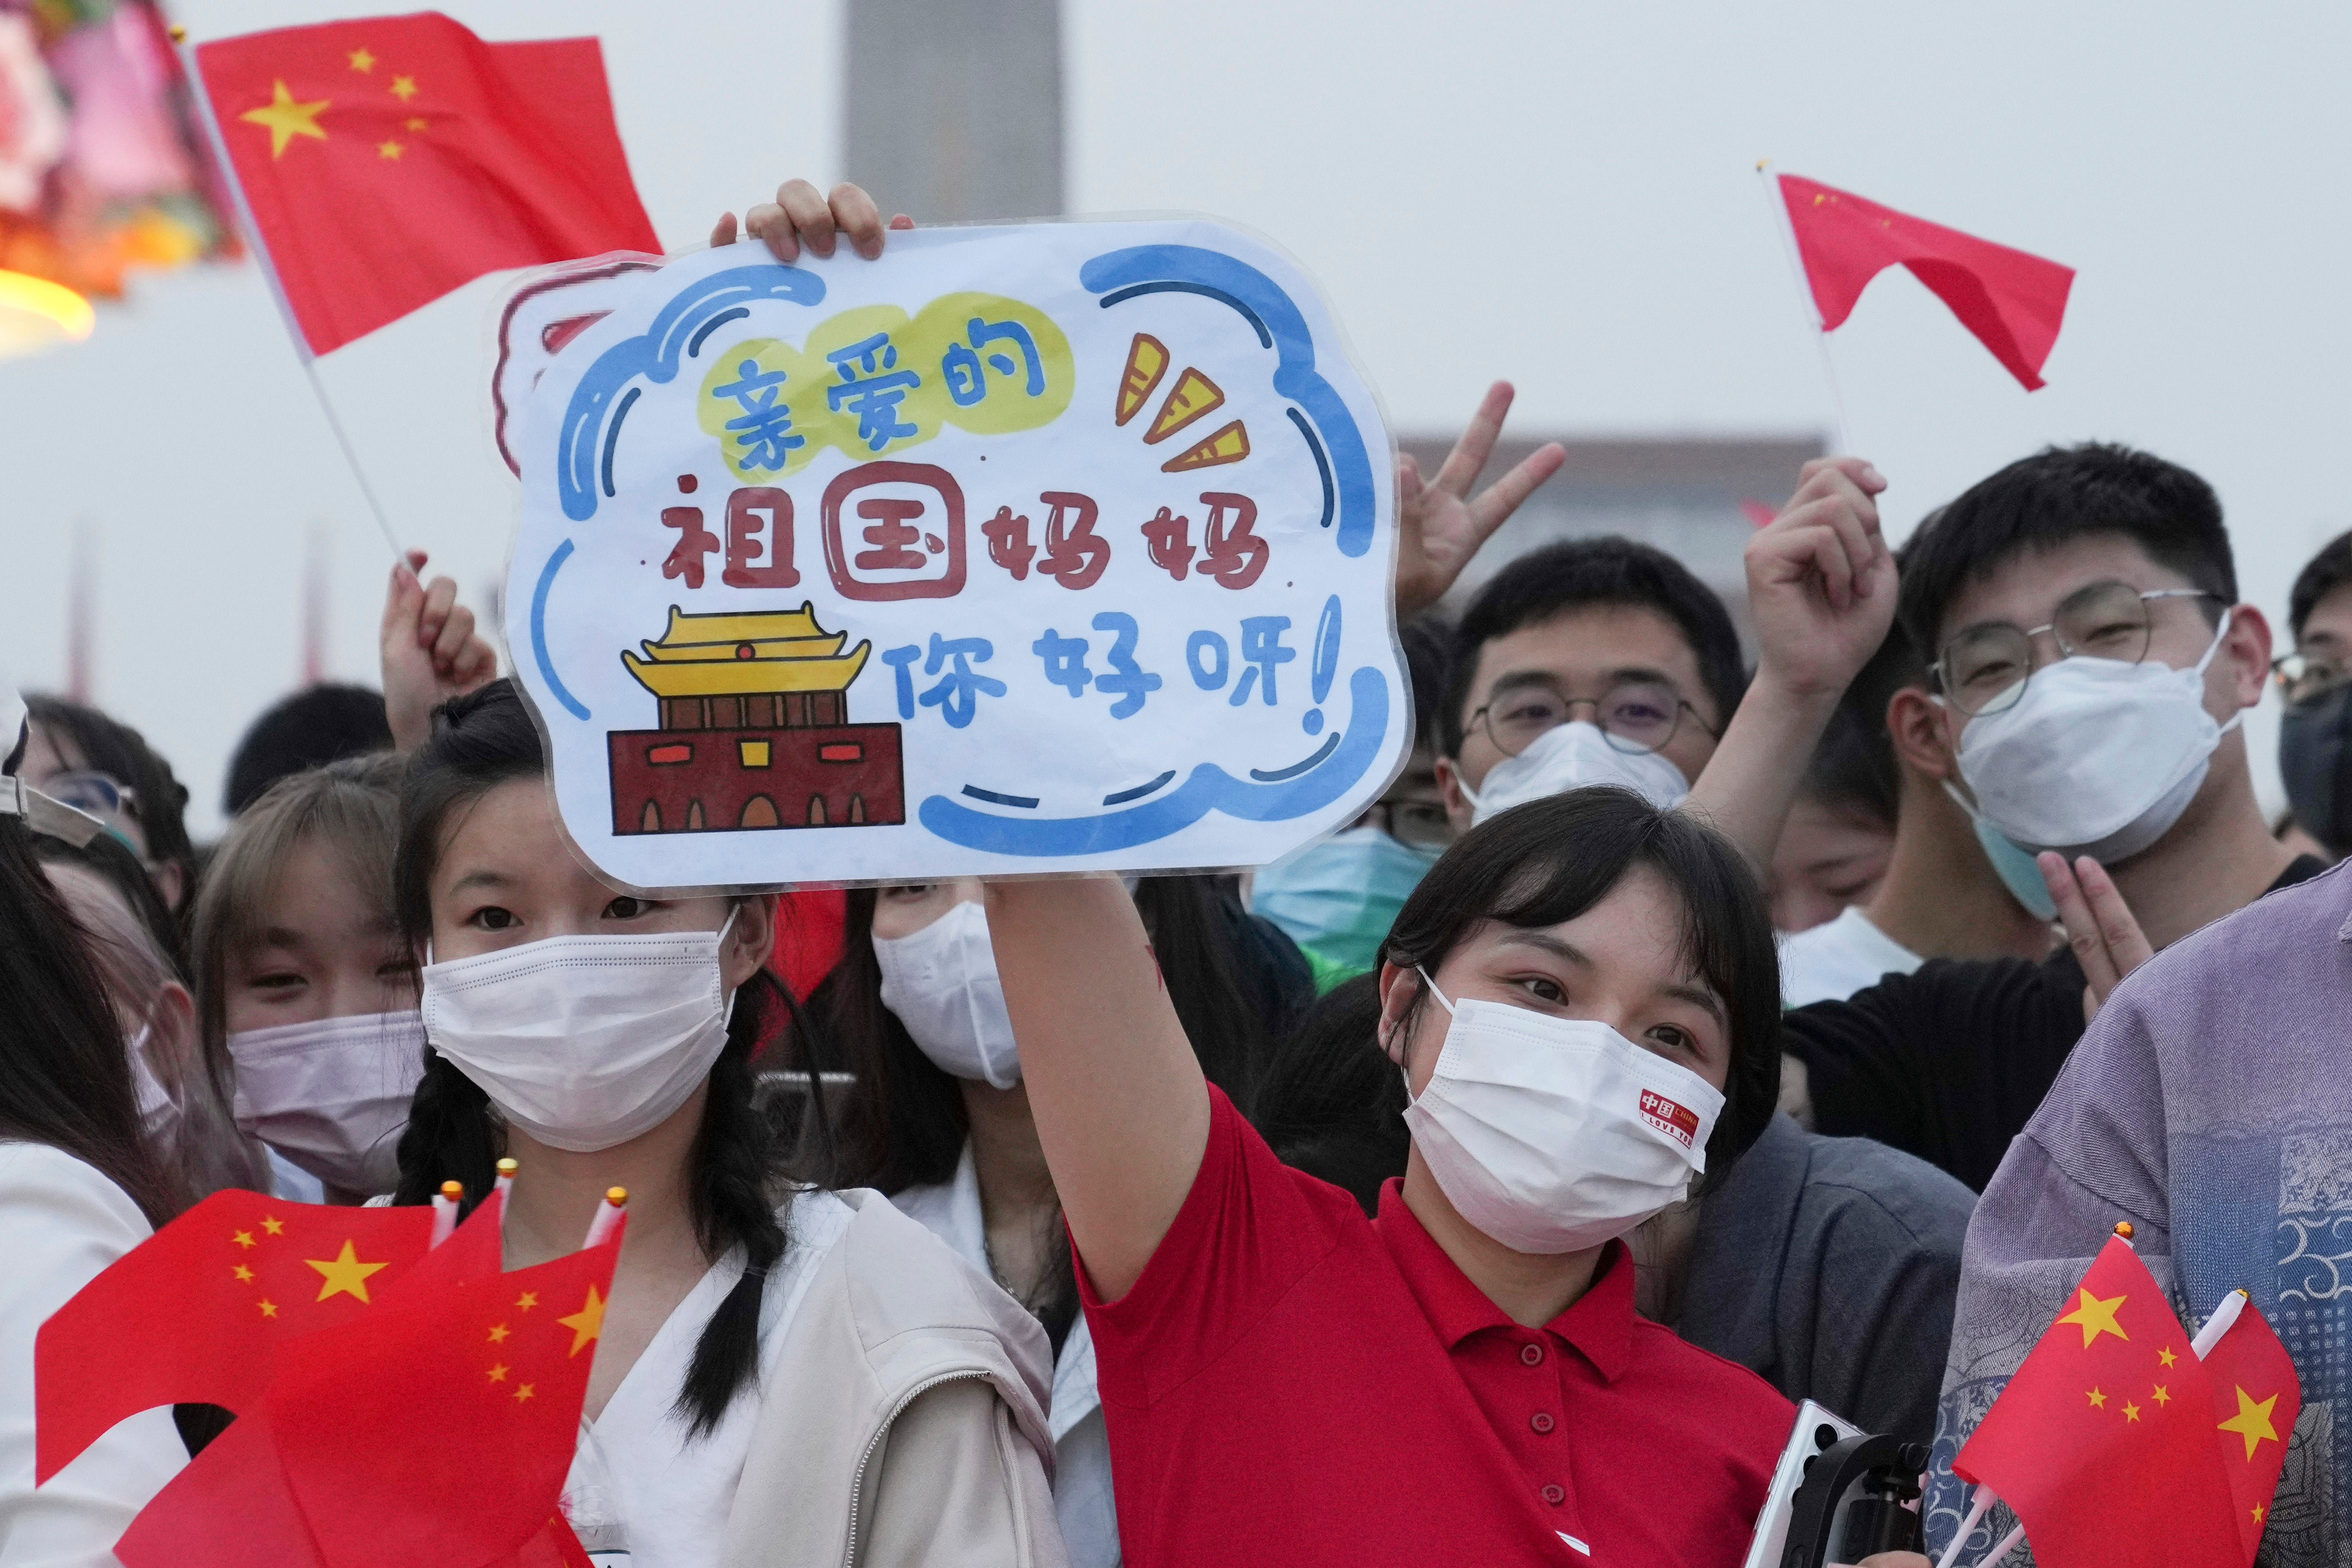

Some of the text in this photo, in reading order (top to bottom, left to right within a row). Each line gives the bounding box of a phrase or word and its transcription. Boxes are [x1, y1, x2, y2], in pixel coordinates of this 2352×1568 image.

[714, 317, 1047, 471] 亲爱的
[661, 461, 1270, 601] 祖国妈妈
[881, 594, 1342, 735] 你好呀!
[1642, 1094, 1675, 1119] 中国
[1674, 1108, 1697, 1127] CHINA
[1650, 1117, 1674, 1134] LOVE
[1680, 1131, 1692, 1146] YOU
